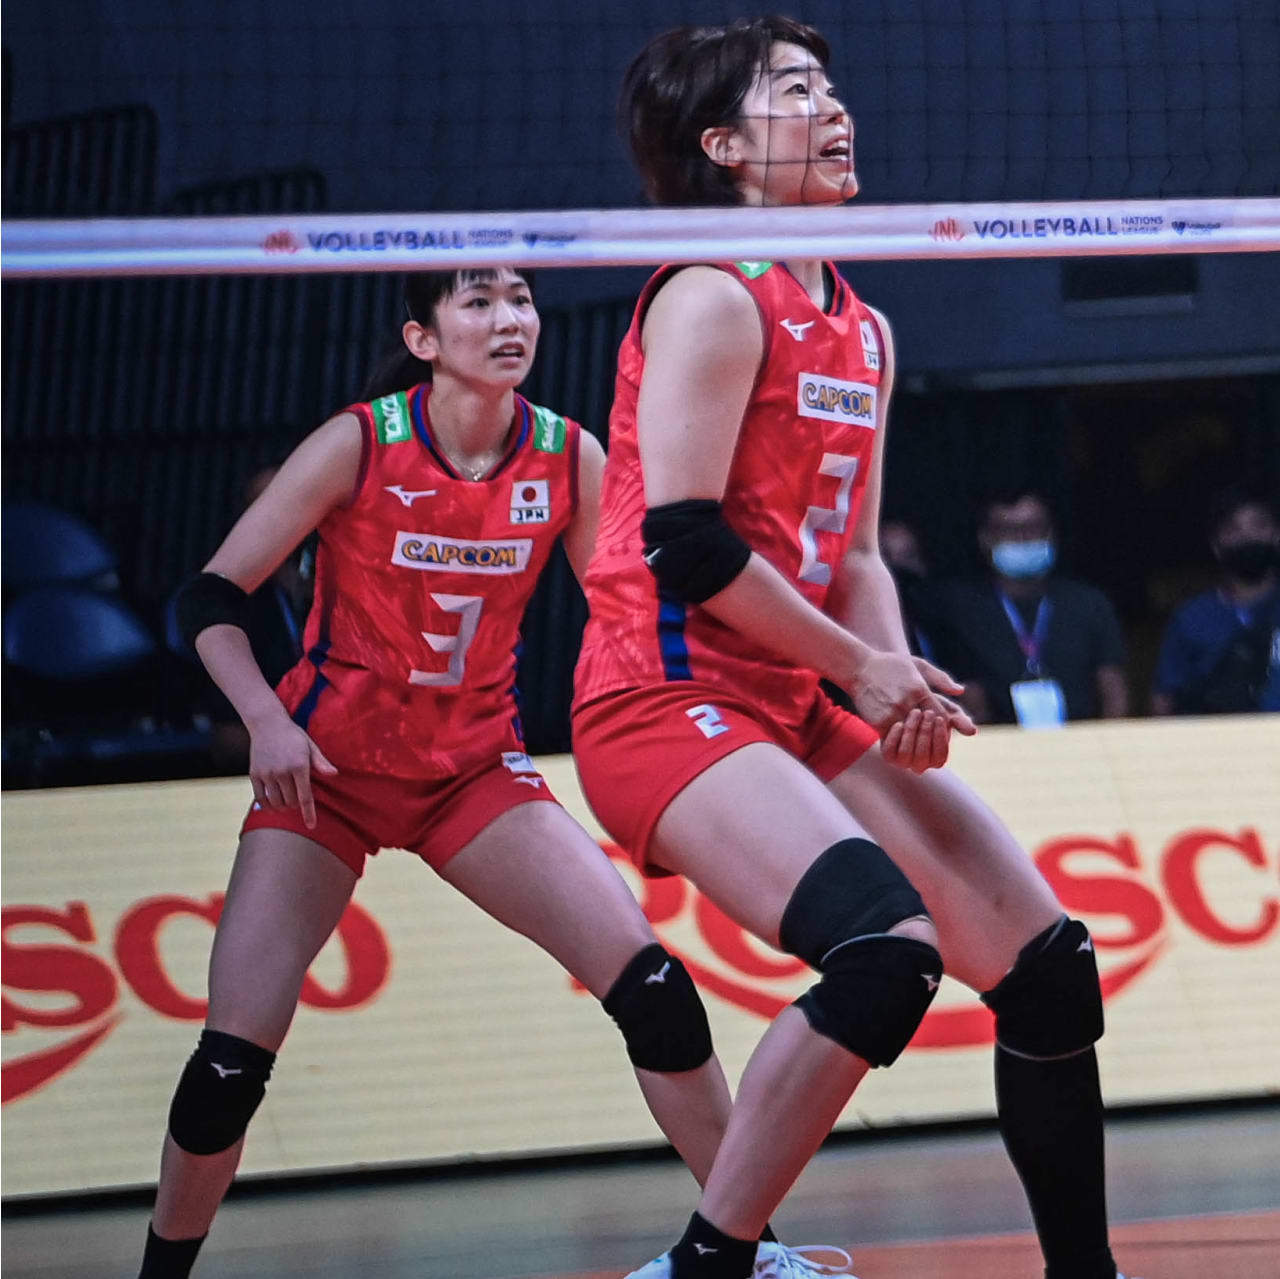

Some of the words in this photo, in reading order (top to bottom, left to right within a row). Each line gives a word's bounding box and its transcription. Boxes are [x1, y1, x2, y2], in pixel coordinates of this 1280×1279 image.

[307, 230, 464, 252] VOLLEYBALL
[973, 216, 1118, 240] VOLLEYBALL
[801, 382, 873, 419] CAPCOM
[515, 509, 544, 521] JPN
[798, 453, 860, 587] 2
[401, 540, 518, 568] CAPCOM
[408, 593, 484, 687] 3
[686, 704, 730, 739] 2
